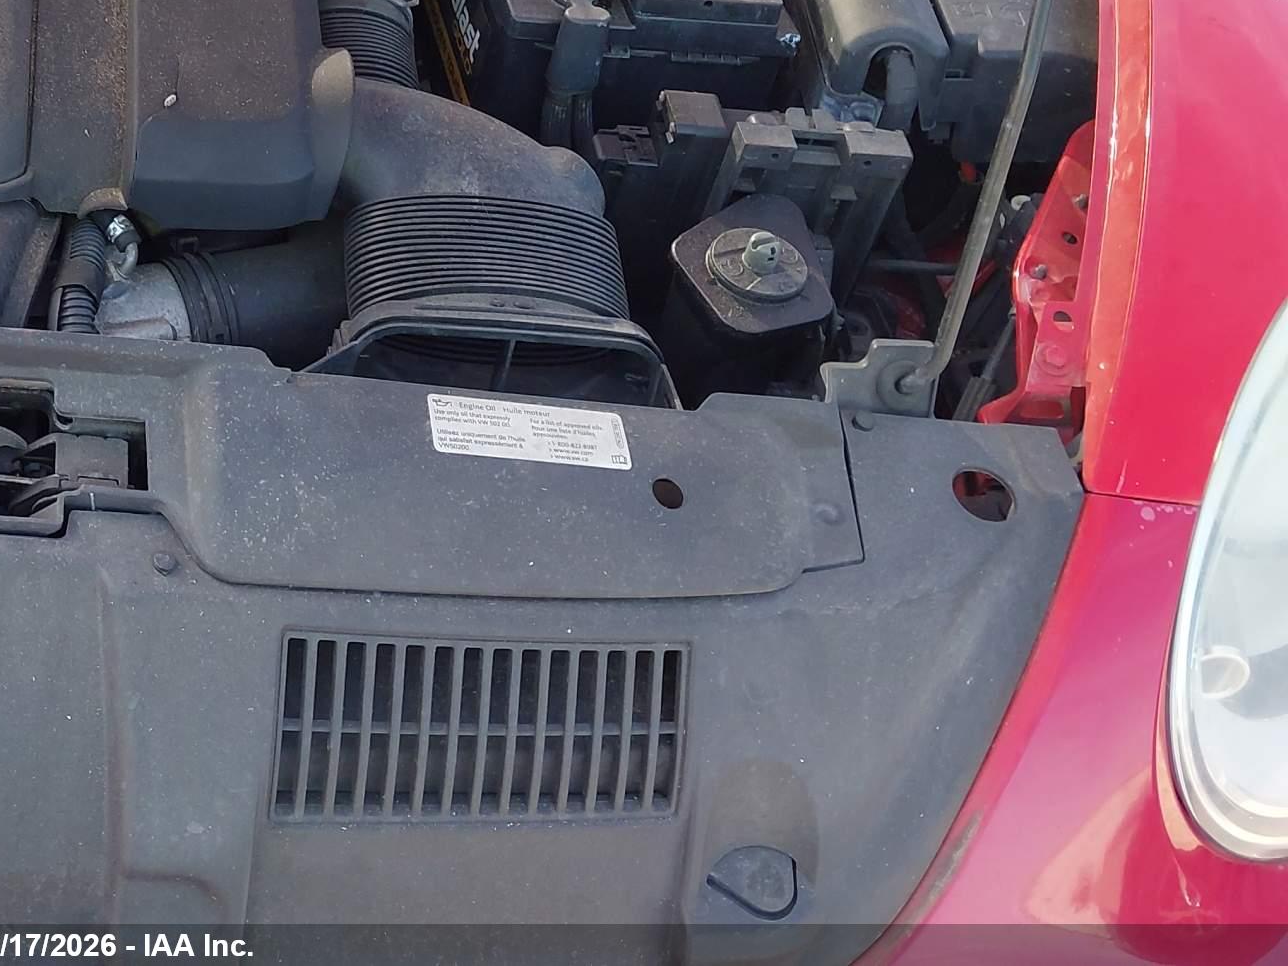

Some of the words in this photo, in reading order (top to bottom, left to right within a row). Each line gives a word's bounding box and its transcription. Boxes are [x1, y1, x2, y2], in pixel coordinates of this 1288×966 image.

[459, 402, 484, 411] Engine
[503, 406, 523, 414] Huile
[523, 409, 550, 417] moteur
